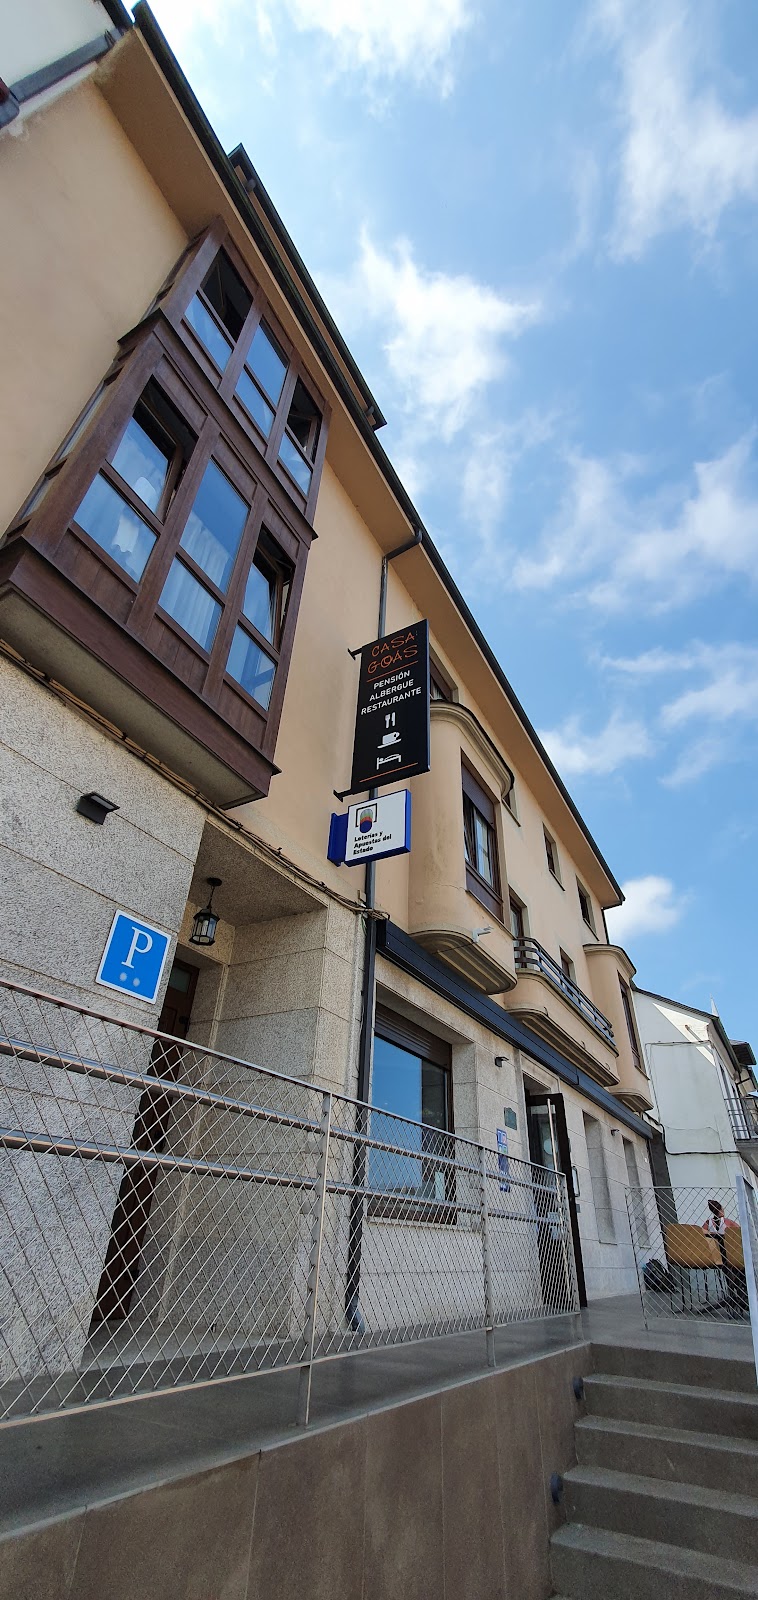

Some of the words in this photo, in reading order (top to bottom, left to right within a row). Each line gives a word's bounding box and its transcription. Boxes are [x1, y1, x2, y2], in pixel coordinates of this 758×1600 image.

[371, 632, 415, 657] CASA
[367, 644, 418, 674] GOAS
[369, 678, 414, 701] ALBERGUE
[373, 670, 411, 690] PENSIÓN
[361, 687, 422, 715] RESTAURANTE
[353, 837, 381, 849] Apuestas
[382, 833, 392, 841] del
[353, 846, 374, 855] Estado
[121, 926, 153, 969] P
